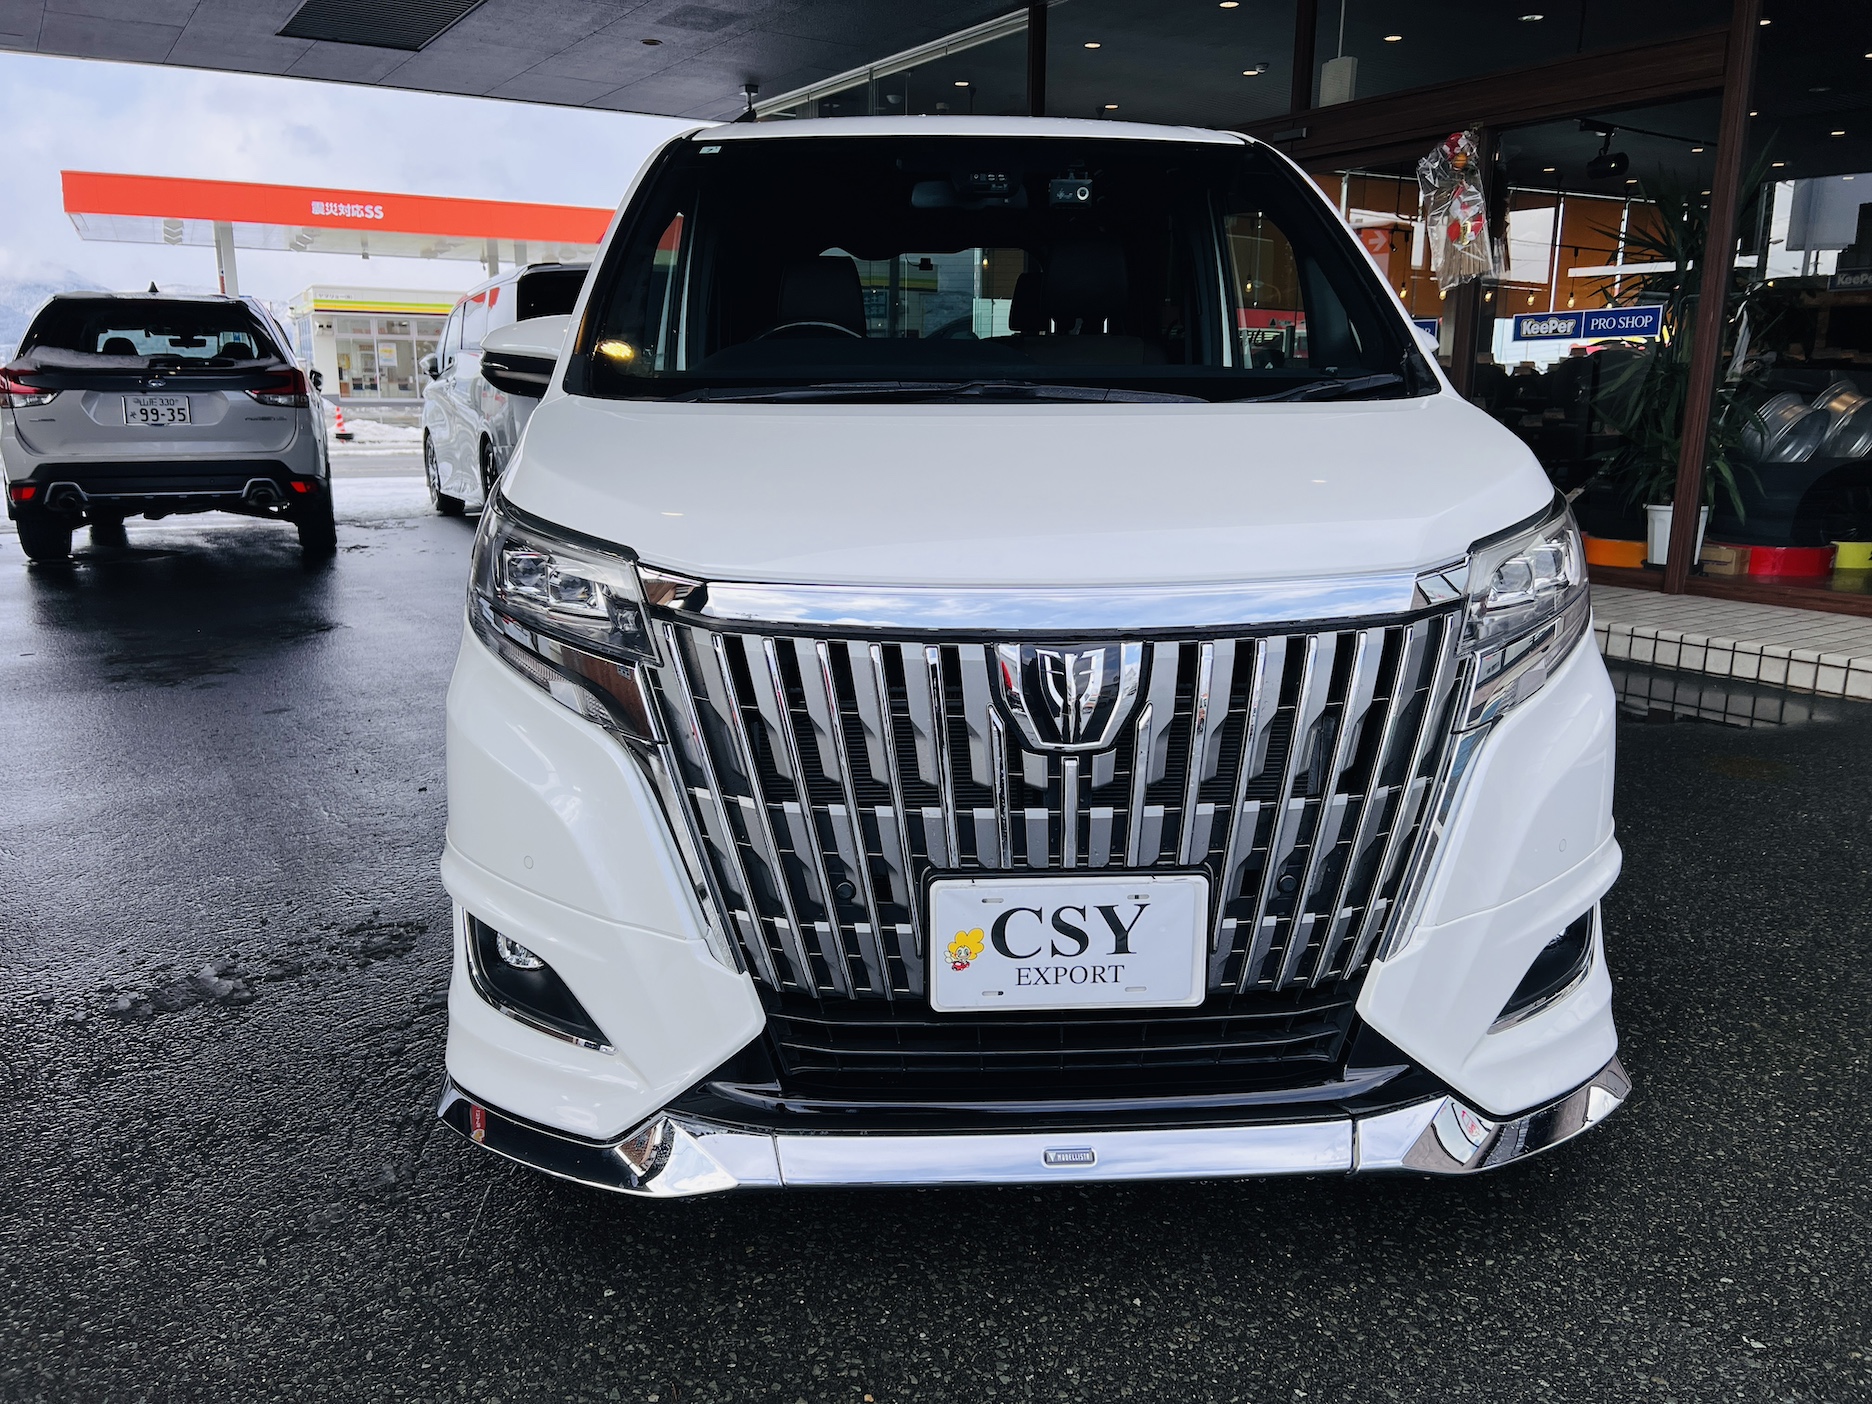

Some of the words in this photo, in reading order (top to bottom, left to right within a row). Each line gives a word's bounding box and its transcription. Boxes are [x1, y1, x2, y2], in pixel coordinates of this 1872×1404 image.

[311, 200, 384, 220] 震災対応SS
[1521, 318, 1577, 336] KeePer
[1590, 317, 1616, 330] PRO
[1617, 315, 1653, 329] SHOP
[159, 398, 175, 406] 330
[140, 407, 186, 422] 99-35
[991, 903, 1151, 960] CSY
[1015, 965, 1125, 986] EXPORT
